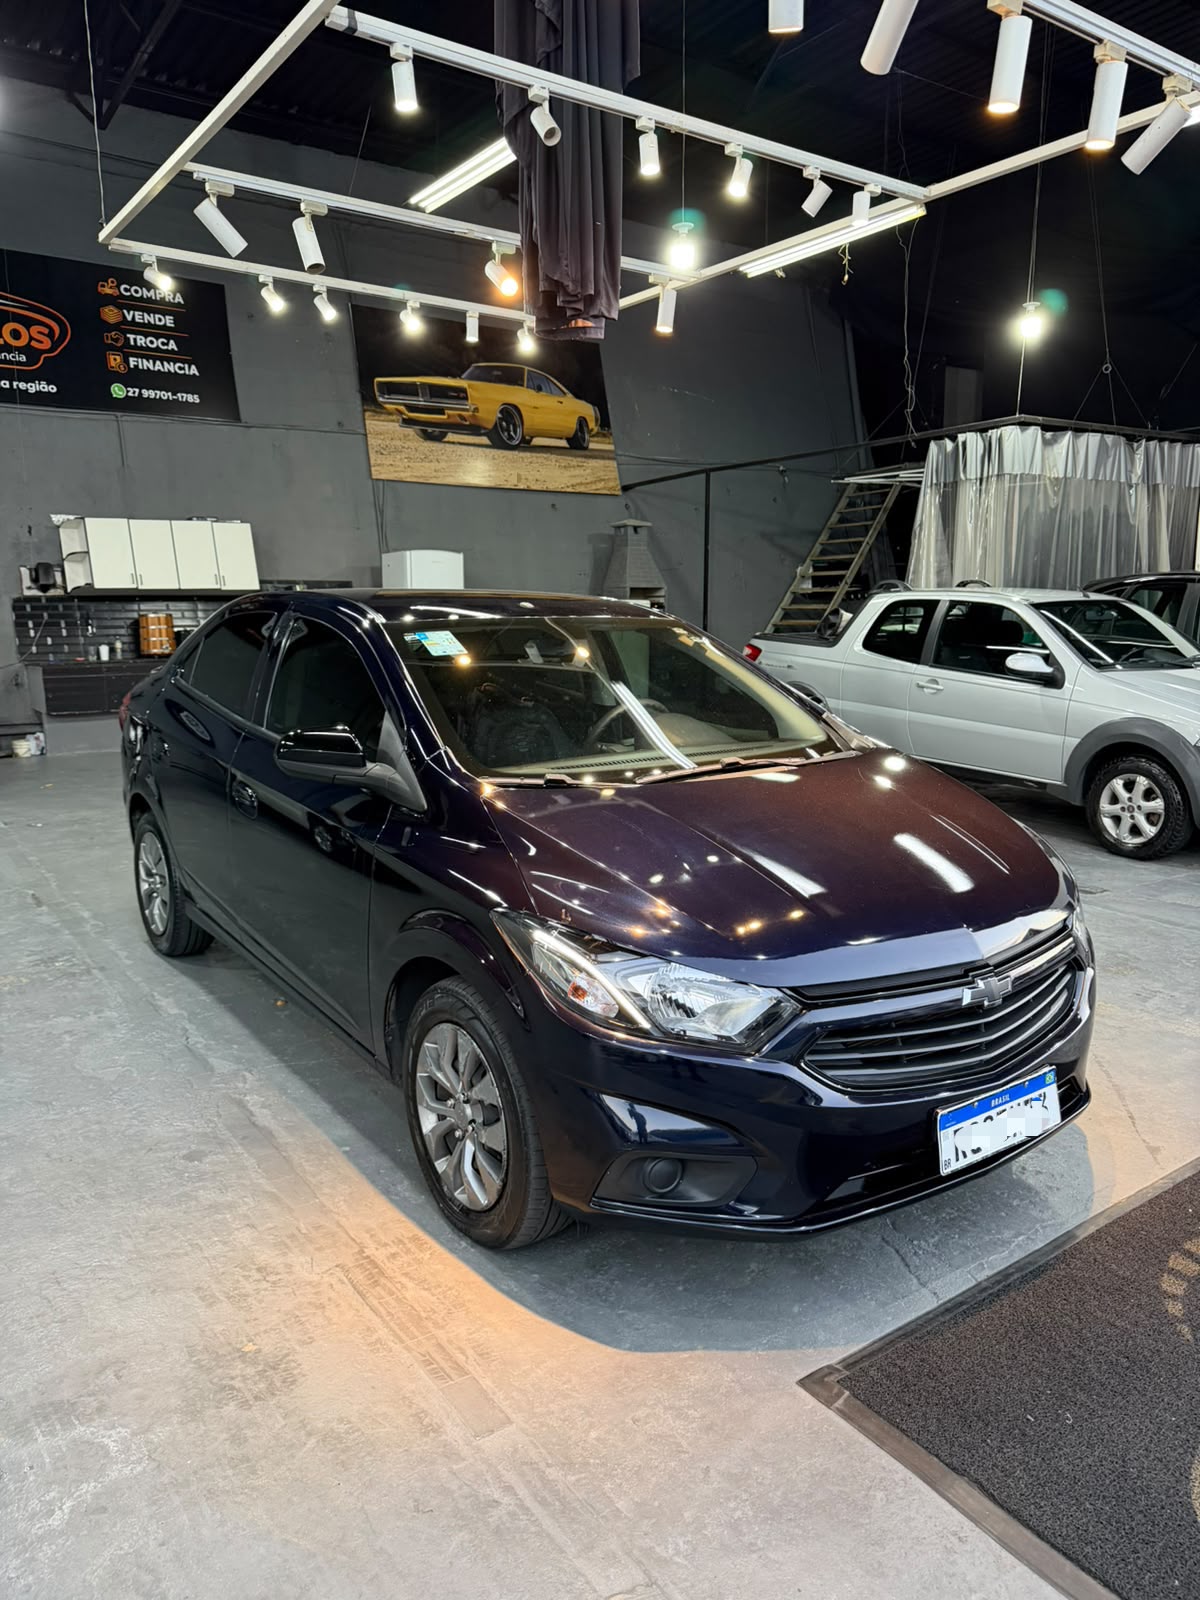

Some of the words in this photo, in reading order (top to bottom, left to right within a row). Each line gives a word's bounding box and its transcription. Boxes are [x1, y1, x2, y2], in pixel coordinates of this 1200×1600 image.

[120, 284, 184, 304] COMPRA
[123, 309, 175, 327] VENDE
[0, 322, 52, 350] OS
[126, 333, 178, 351] TROCA
[0, 351, 27, 362] ncia
[128, 356, 200, 376] FINANCIA
[12, 380, 58, 393] região
[126, 387, 140, 397] 27
[141, 388, 200, 403] 99701-1785
[991, 1094, 1010, 1107] BRASIL
[944, 1158, 951, 1170] BR
